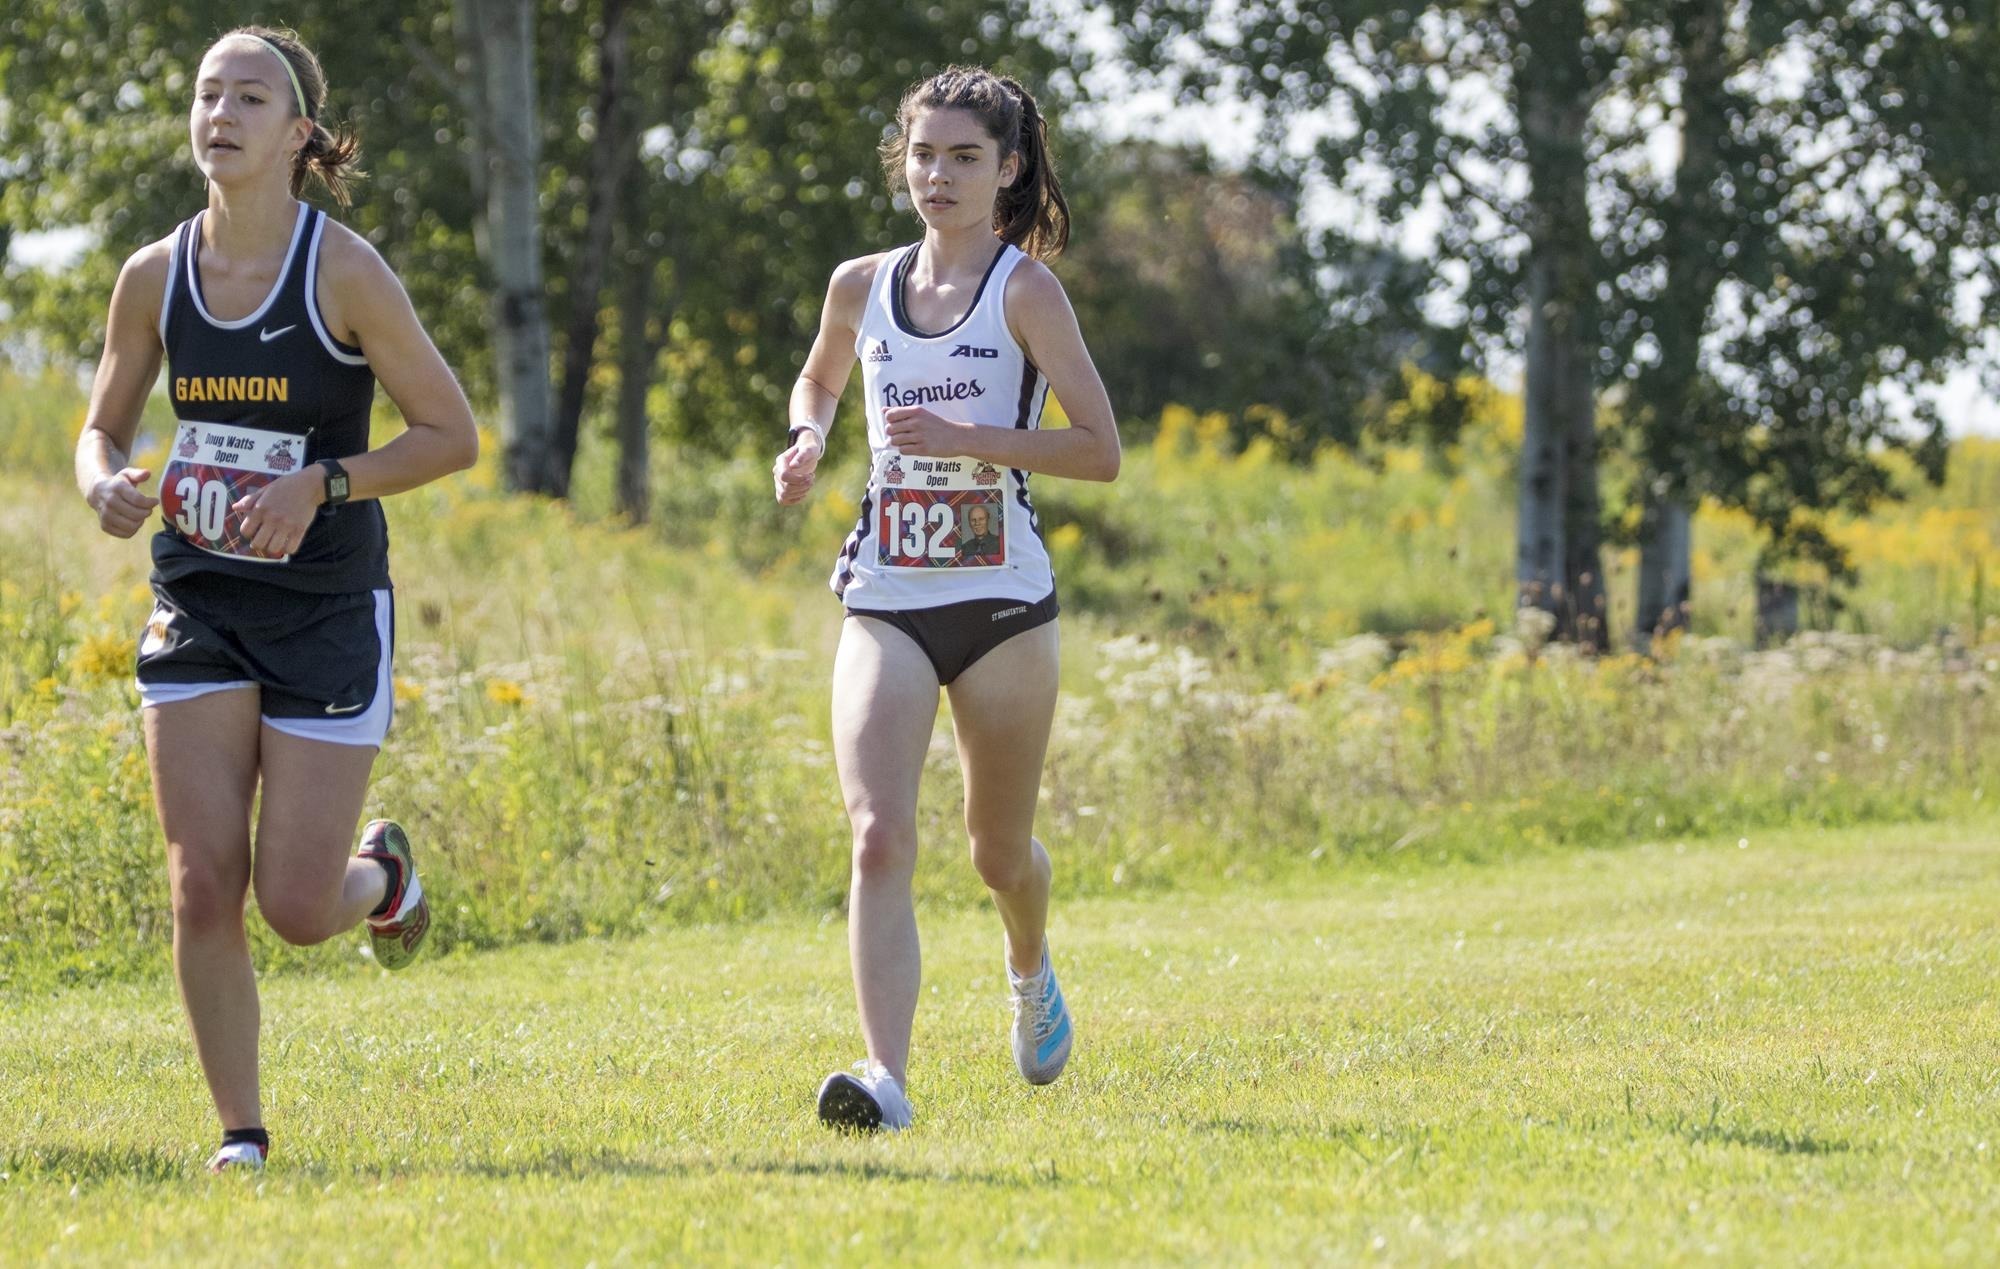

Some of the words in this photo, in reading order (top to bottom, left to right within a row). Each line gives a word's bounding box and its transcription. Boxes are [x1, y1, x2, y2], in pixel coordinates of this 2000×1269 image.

[869, 353, 893, 362] adidas
[949, 344, 998, 359] A10
[175, 376, 288, 402] GANNON
[882, 377, 986, 407] Bonnies
[205, 433, 225, 447] Doug
[226, 435, 255, 451] Watts
[214, 450, 239, 464] Open
[913, 460, 933, 473] Doug
[935, 461, 961, 473] Watts
[926, 474, 948, 487] Open
[175, 476, 228, 541] 30
[884, 501, 956, 558] 132
